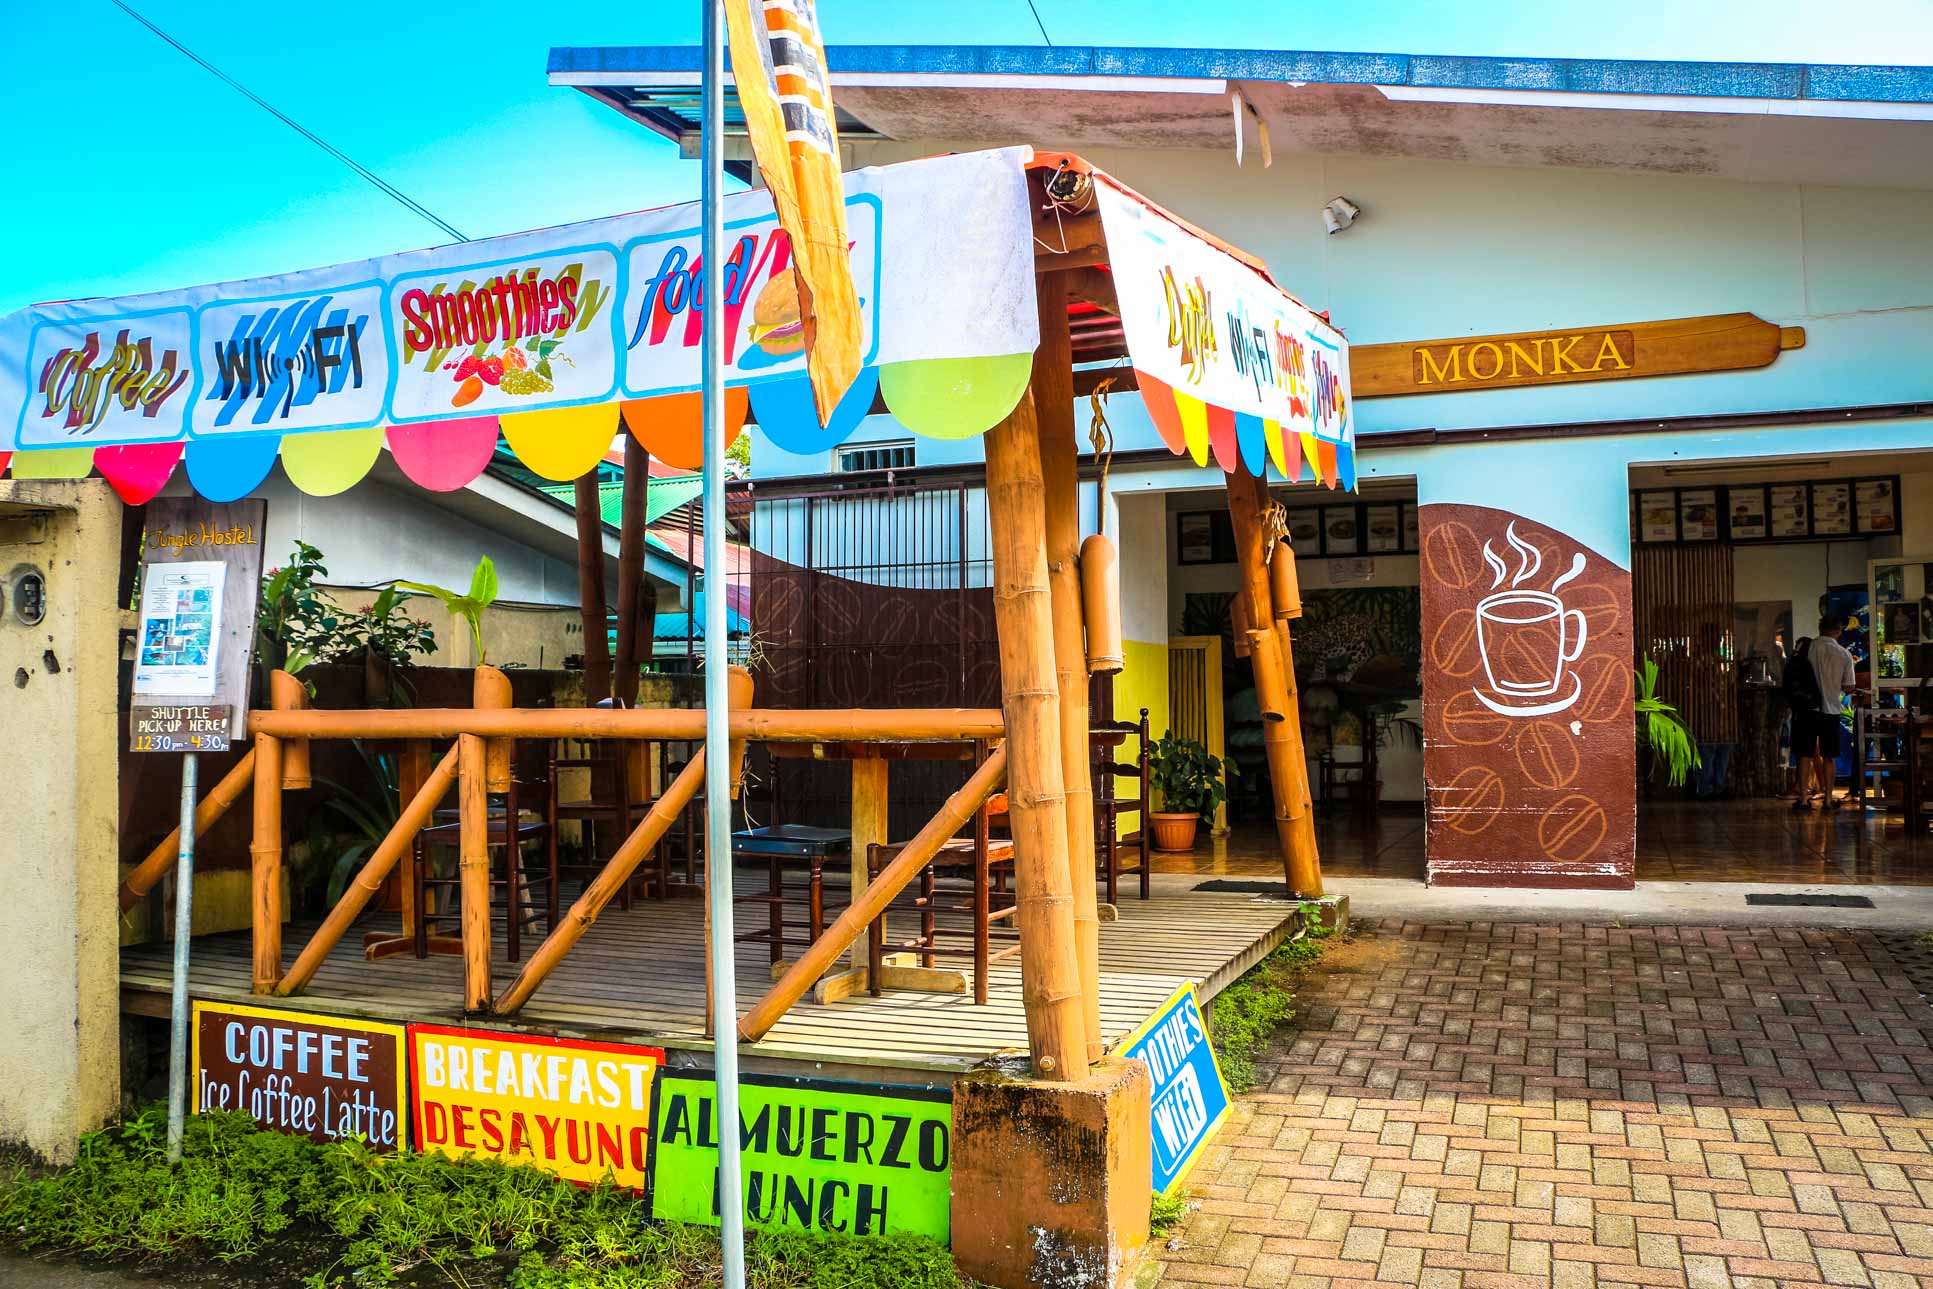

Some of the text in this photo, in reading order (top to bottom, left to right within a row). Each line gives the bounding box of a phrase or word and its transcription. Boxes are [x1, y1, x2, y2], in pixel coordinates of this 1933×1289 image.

[401, 272, 579, 352] Smoothies
[46, 343, 172, 436] Coffee
[1414, 332, 1632, 386] MONKA
[138, 717, 229, 735] PICK-UP HERE!
[151, 705, 211, 720] SHUTTLE
[225, 1021, 370, 1084] COFFEE
[424, 1042, 650, 1111] BREAKFAST
[200, 1067, 396, 1146] Ice Coffee Latte
[661, 1094, 949, 1173] ALMUERZO
